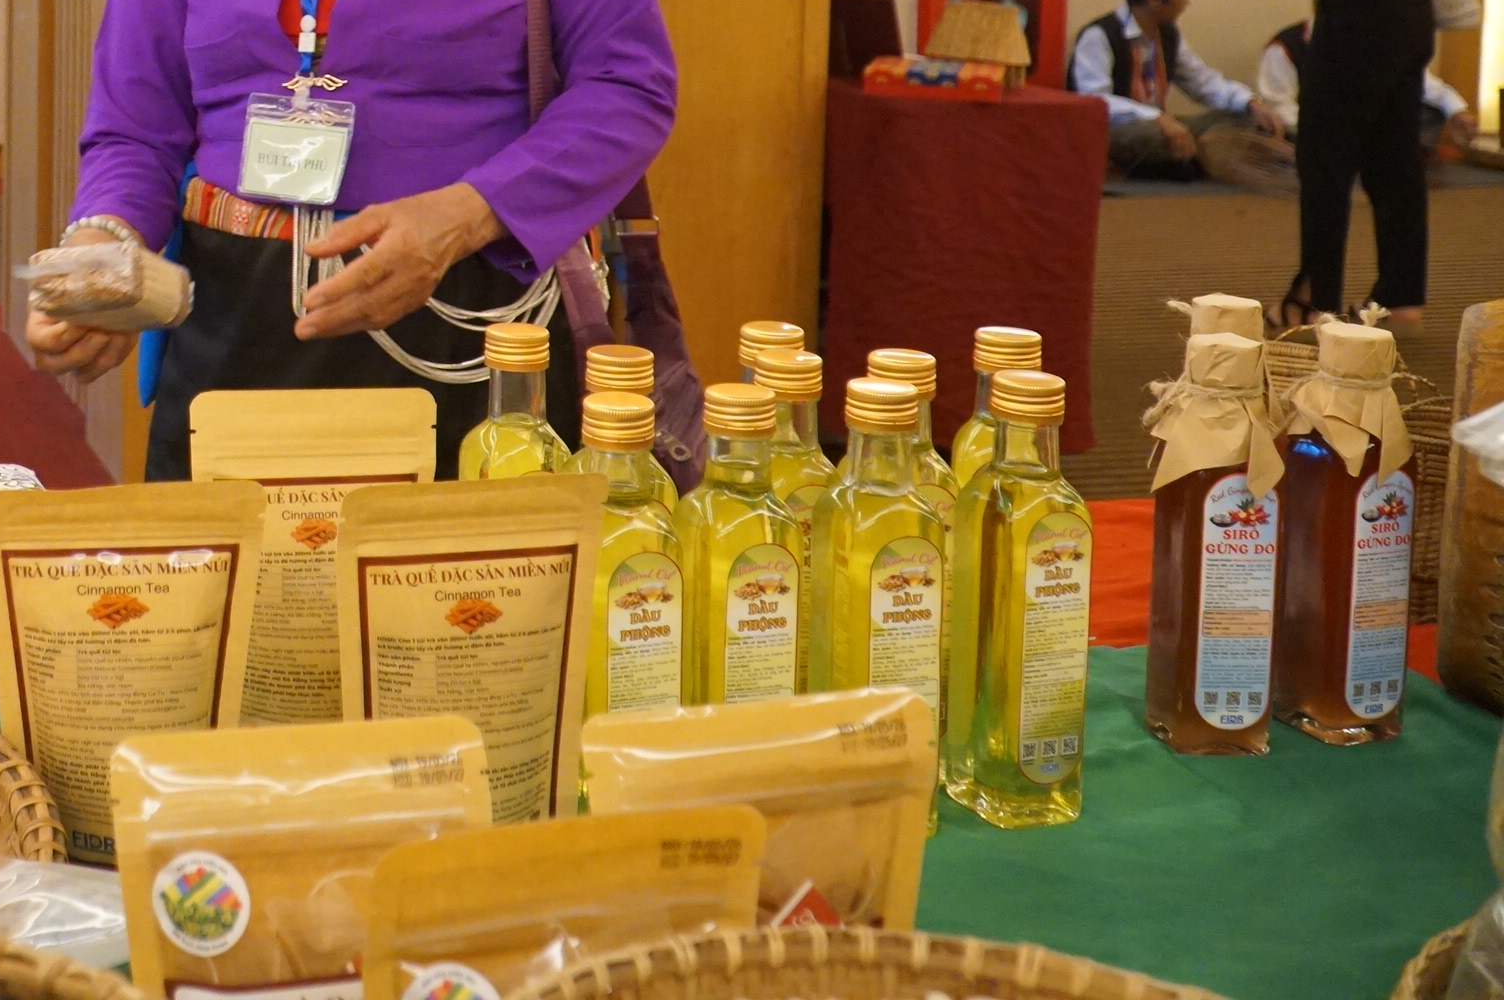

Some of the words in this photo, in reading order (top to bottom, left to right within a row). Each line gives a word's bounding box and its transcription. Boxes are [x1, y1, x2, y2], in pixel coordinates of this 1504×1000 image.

[267, 487, 285, 504] UẾ
[281, 510, 338, 521] Cinnamon
[12, 562, 43, 578] TRÀ
[370, 570, 403, 586] TRÀ
[406, 565, 438, 588] QUẾ
[441, 567, 473, 585] ĐẶC
[509, 558, 546, 578] MIỀN
[76, 584, 141, 597] Cinnamon
[146, 582, 170, 594] Tea
[434, 588, 495, 602] Cinnamon
[498, 586, 522, 598] Tea
[72, 829, 115, 856] FIDR
